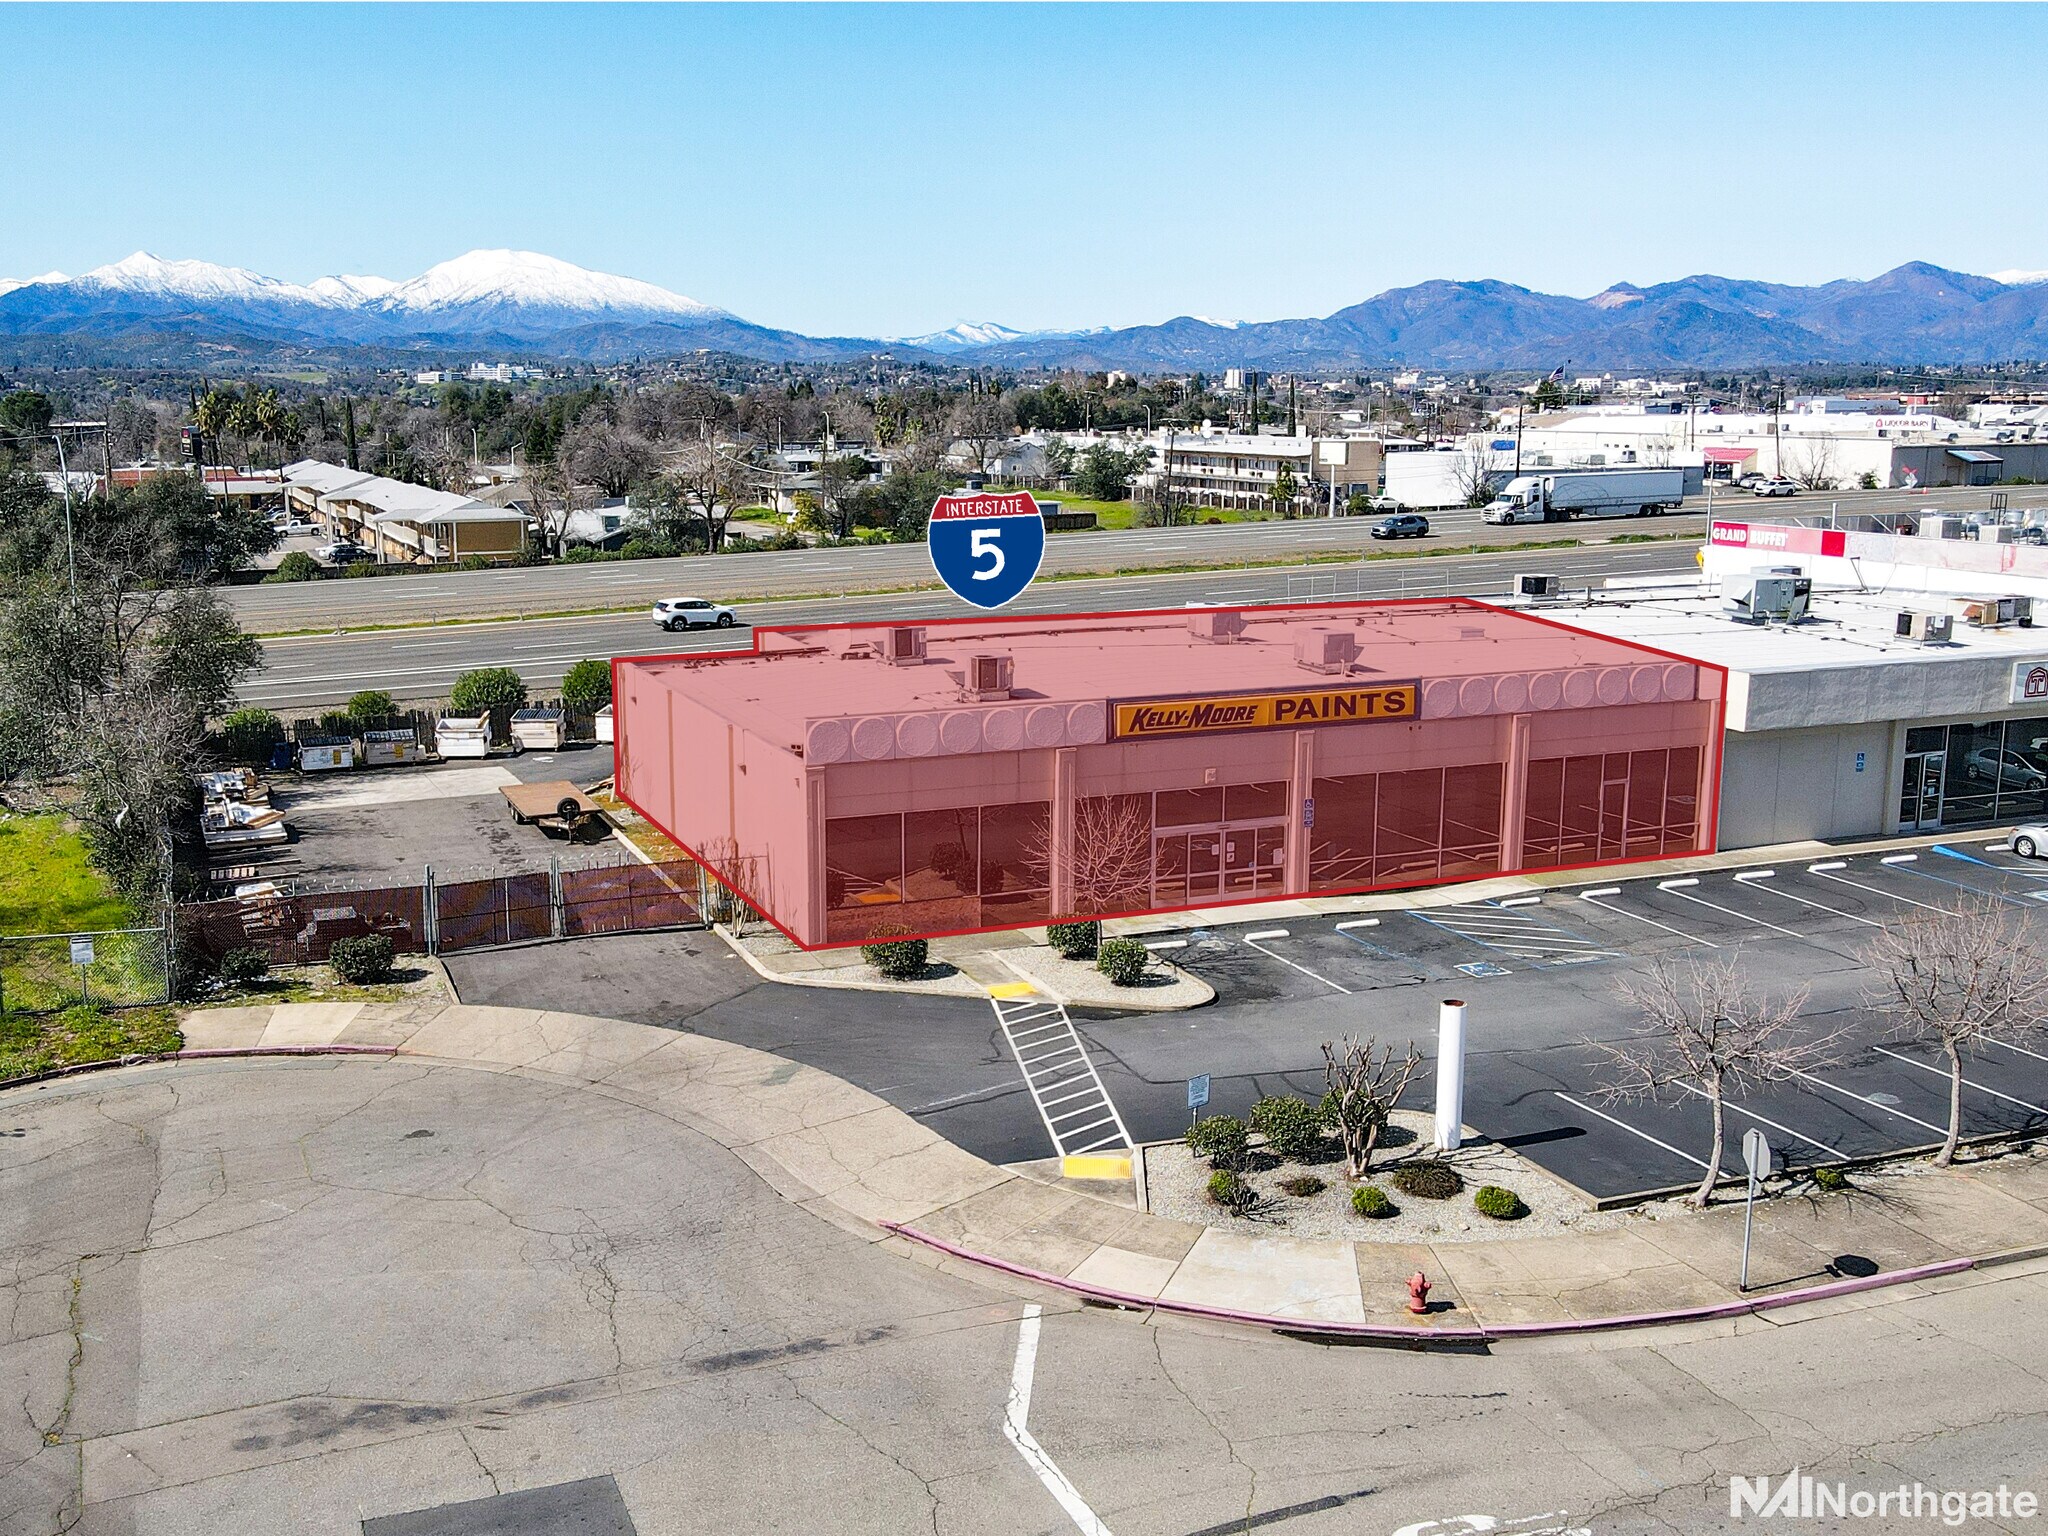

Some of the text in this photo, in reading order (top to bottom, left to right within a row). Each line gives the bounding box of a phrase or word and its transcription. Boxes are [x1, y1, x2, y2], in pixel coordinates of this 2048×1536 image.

[1712, 527, 1788, 547] GRAND BUFFET
[1275, 691, 1407, 721] PAINTS
